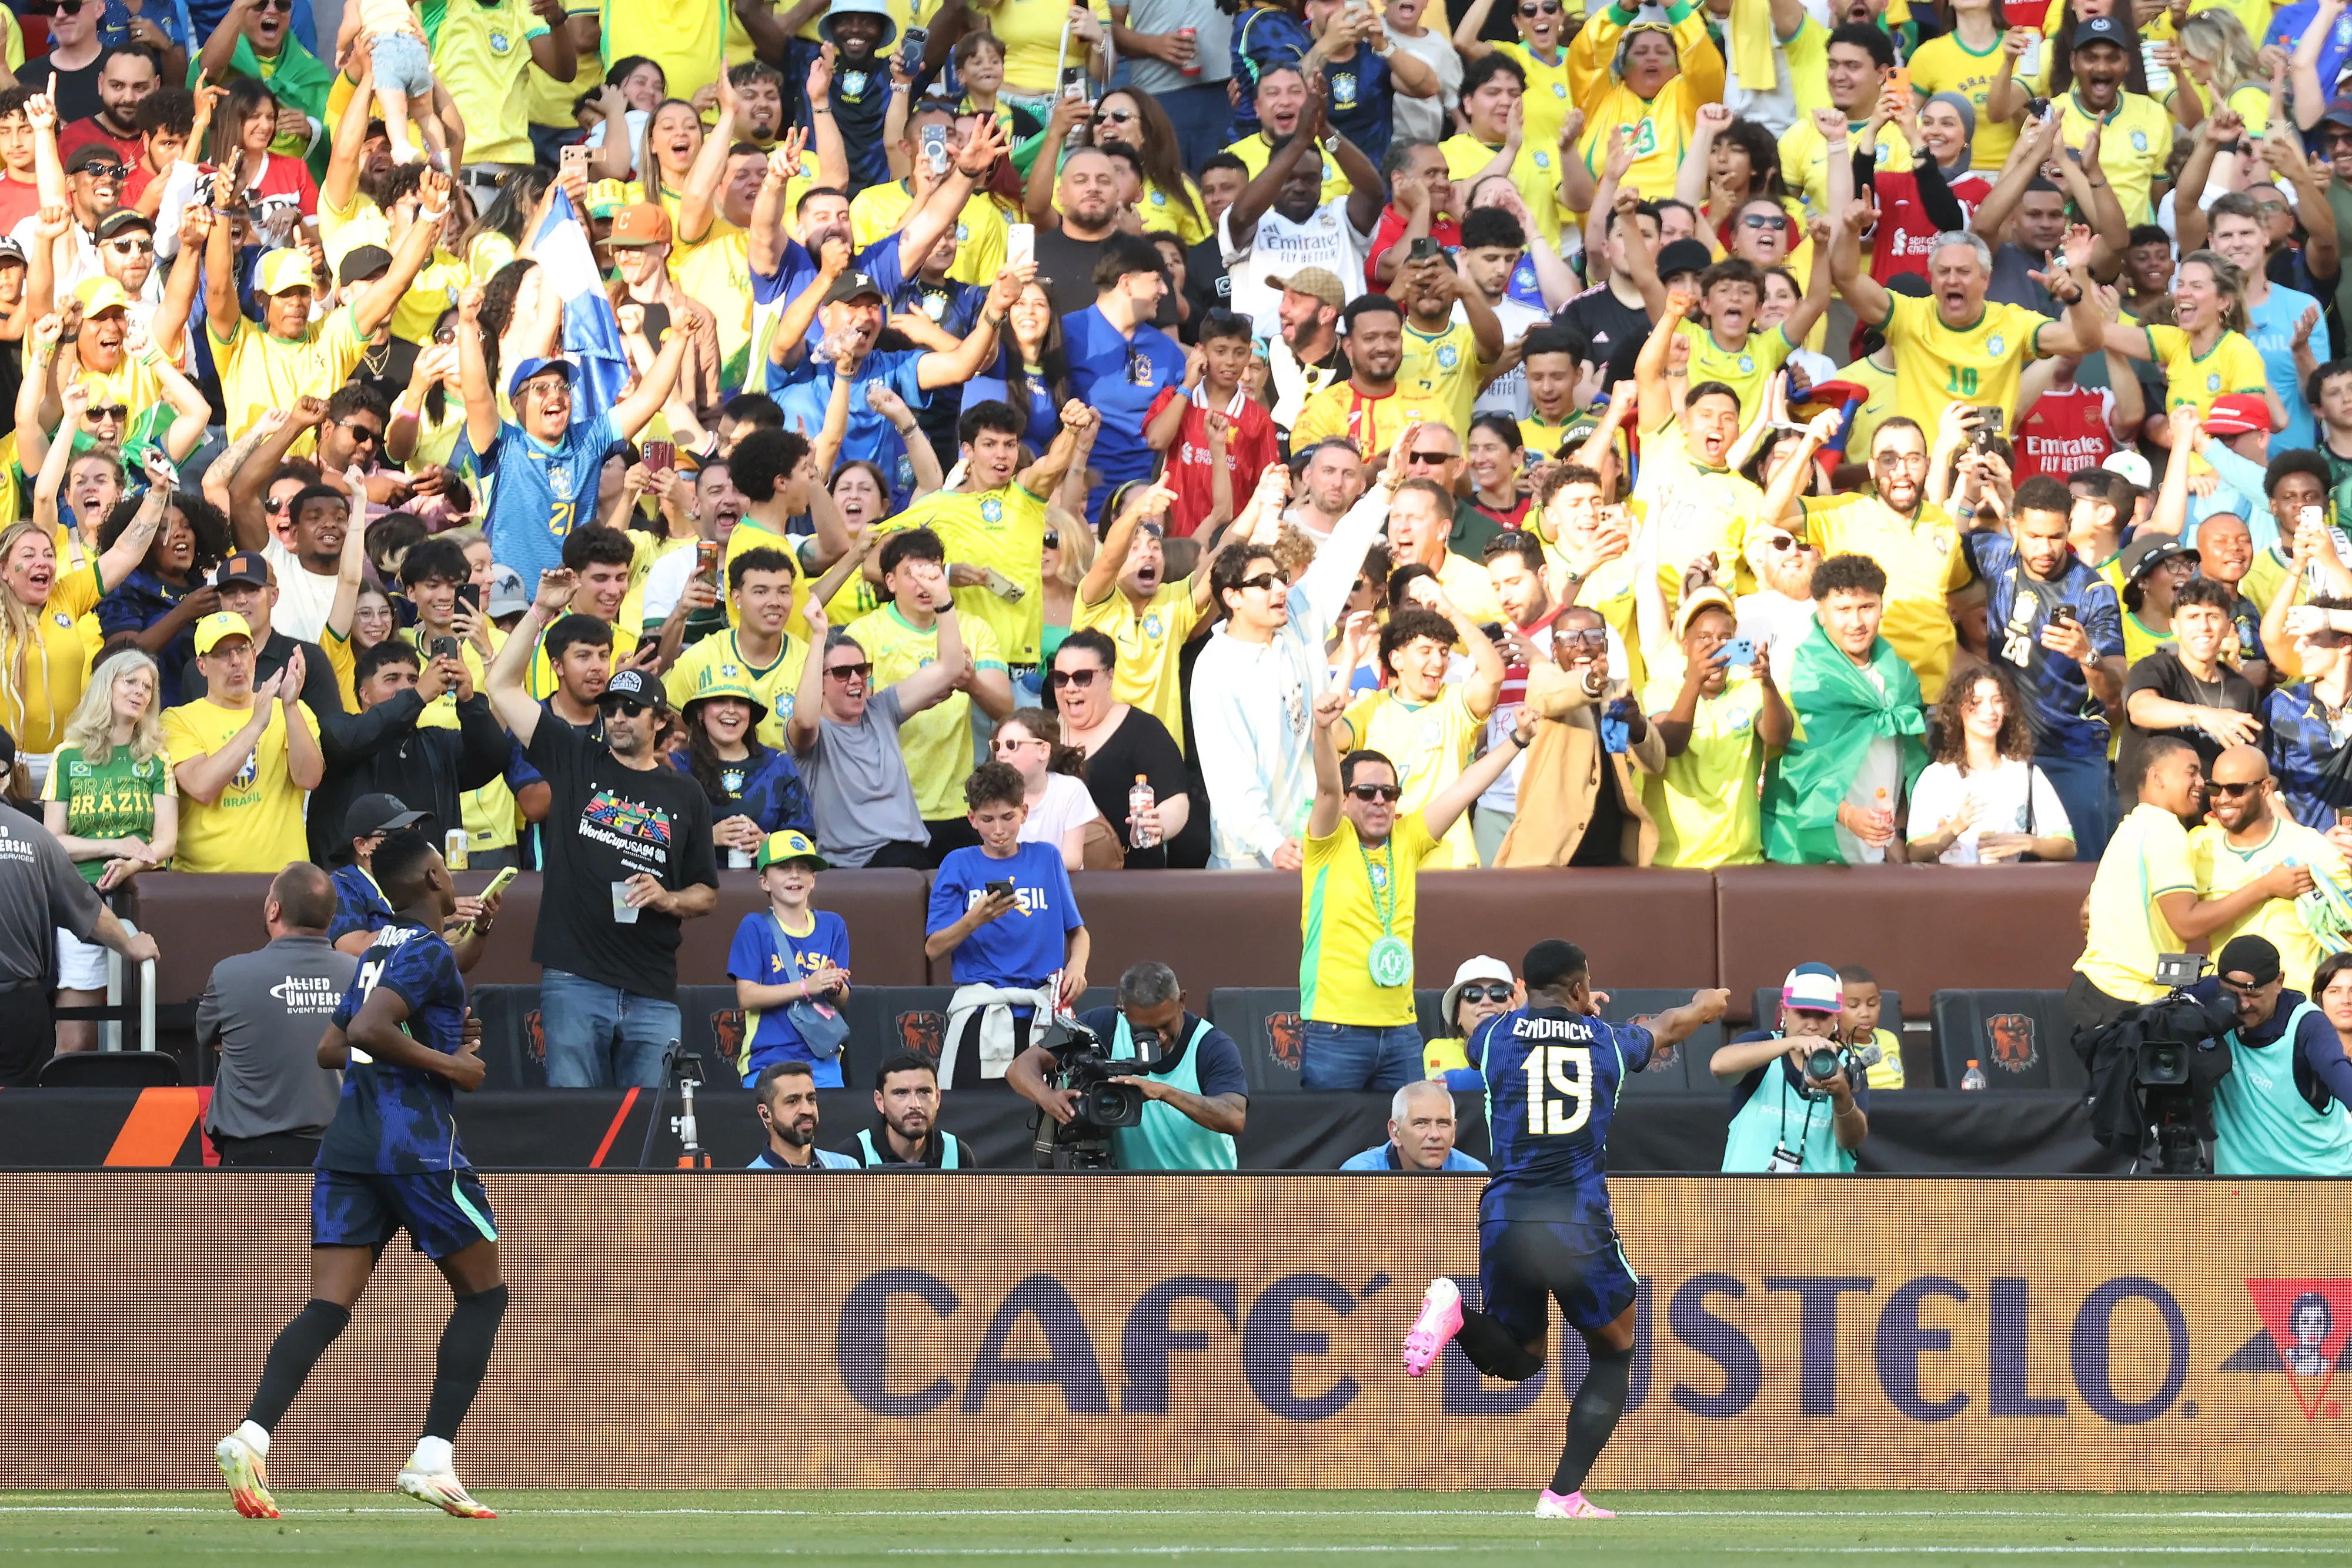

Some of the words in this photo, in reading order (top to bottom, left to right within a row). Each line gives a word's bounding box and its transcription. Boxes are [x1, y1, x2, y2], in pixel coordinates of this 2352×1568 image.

[1267, 232, 1339, 252] Emirate
[1281, 252, 1296, 263] FLY
[1486, 382, 1516, 396] ETTE
[1946, 364, 1977, 396] 10
[2026, 435, 2104, 456] Emirates
[2040, 456, 2060, 473] FLY
[549, 502, 576, 536] 21
[2000, 627, 2031, 668] 20
[69, 793, 154, 816] BRAZIL
[222, 792, 262, 808] BRASIL
[0, 853, 35, 864] SERVICES
[967, 887, 1047, 911] BSIL
[285, 975, 330, 991] ALLIED
[286, 992, 346, 1007] UNIVERS
[1512, 1017, 1594, 1040] ENDRICK
[1520, 1045, 1593, 1135] 19
[837, 1266, 1392, 1421] CAFÉ
